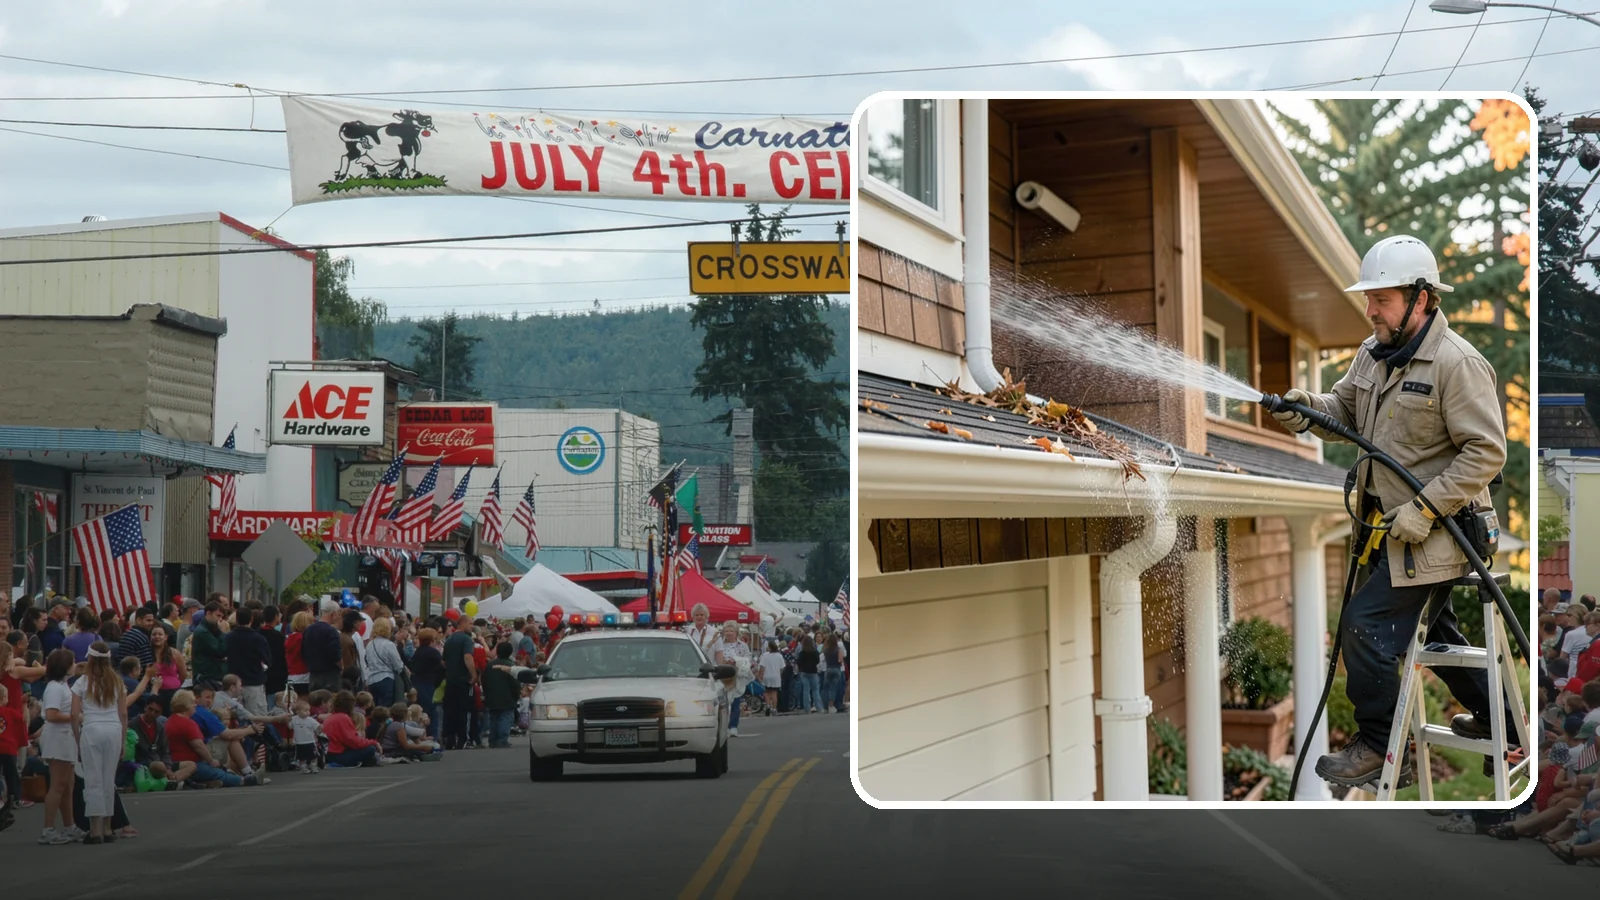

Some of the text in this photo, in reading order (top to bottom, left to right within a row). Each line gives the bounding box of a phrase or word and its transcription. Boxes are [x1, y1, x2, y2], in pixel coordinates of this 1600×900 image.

[481, 141, 605, 192] JULY
[632, 150, 746, 198] 4th.
[696, 254, 850, 280] CROSSWA
[282, 379, 374, 420] ACE
[406, 409, 485, 422] CEDAR LOG
[283, 421, 371, 436] Hardware
[416, 428, 477, 447] Coca-Cola
[95, 485, 124, 494] Vincent
[127, 485, 136, 495] de
[137, 486, 155, 495] Paul
[688, 526, 741, 535] CRNATION
[699, 535, 730, 543] GLASS
